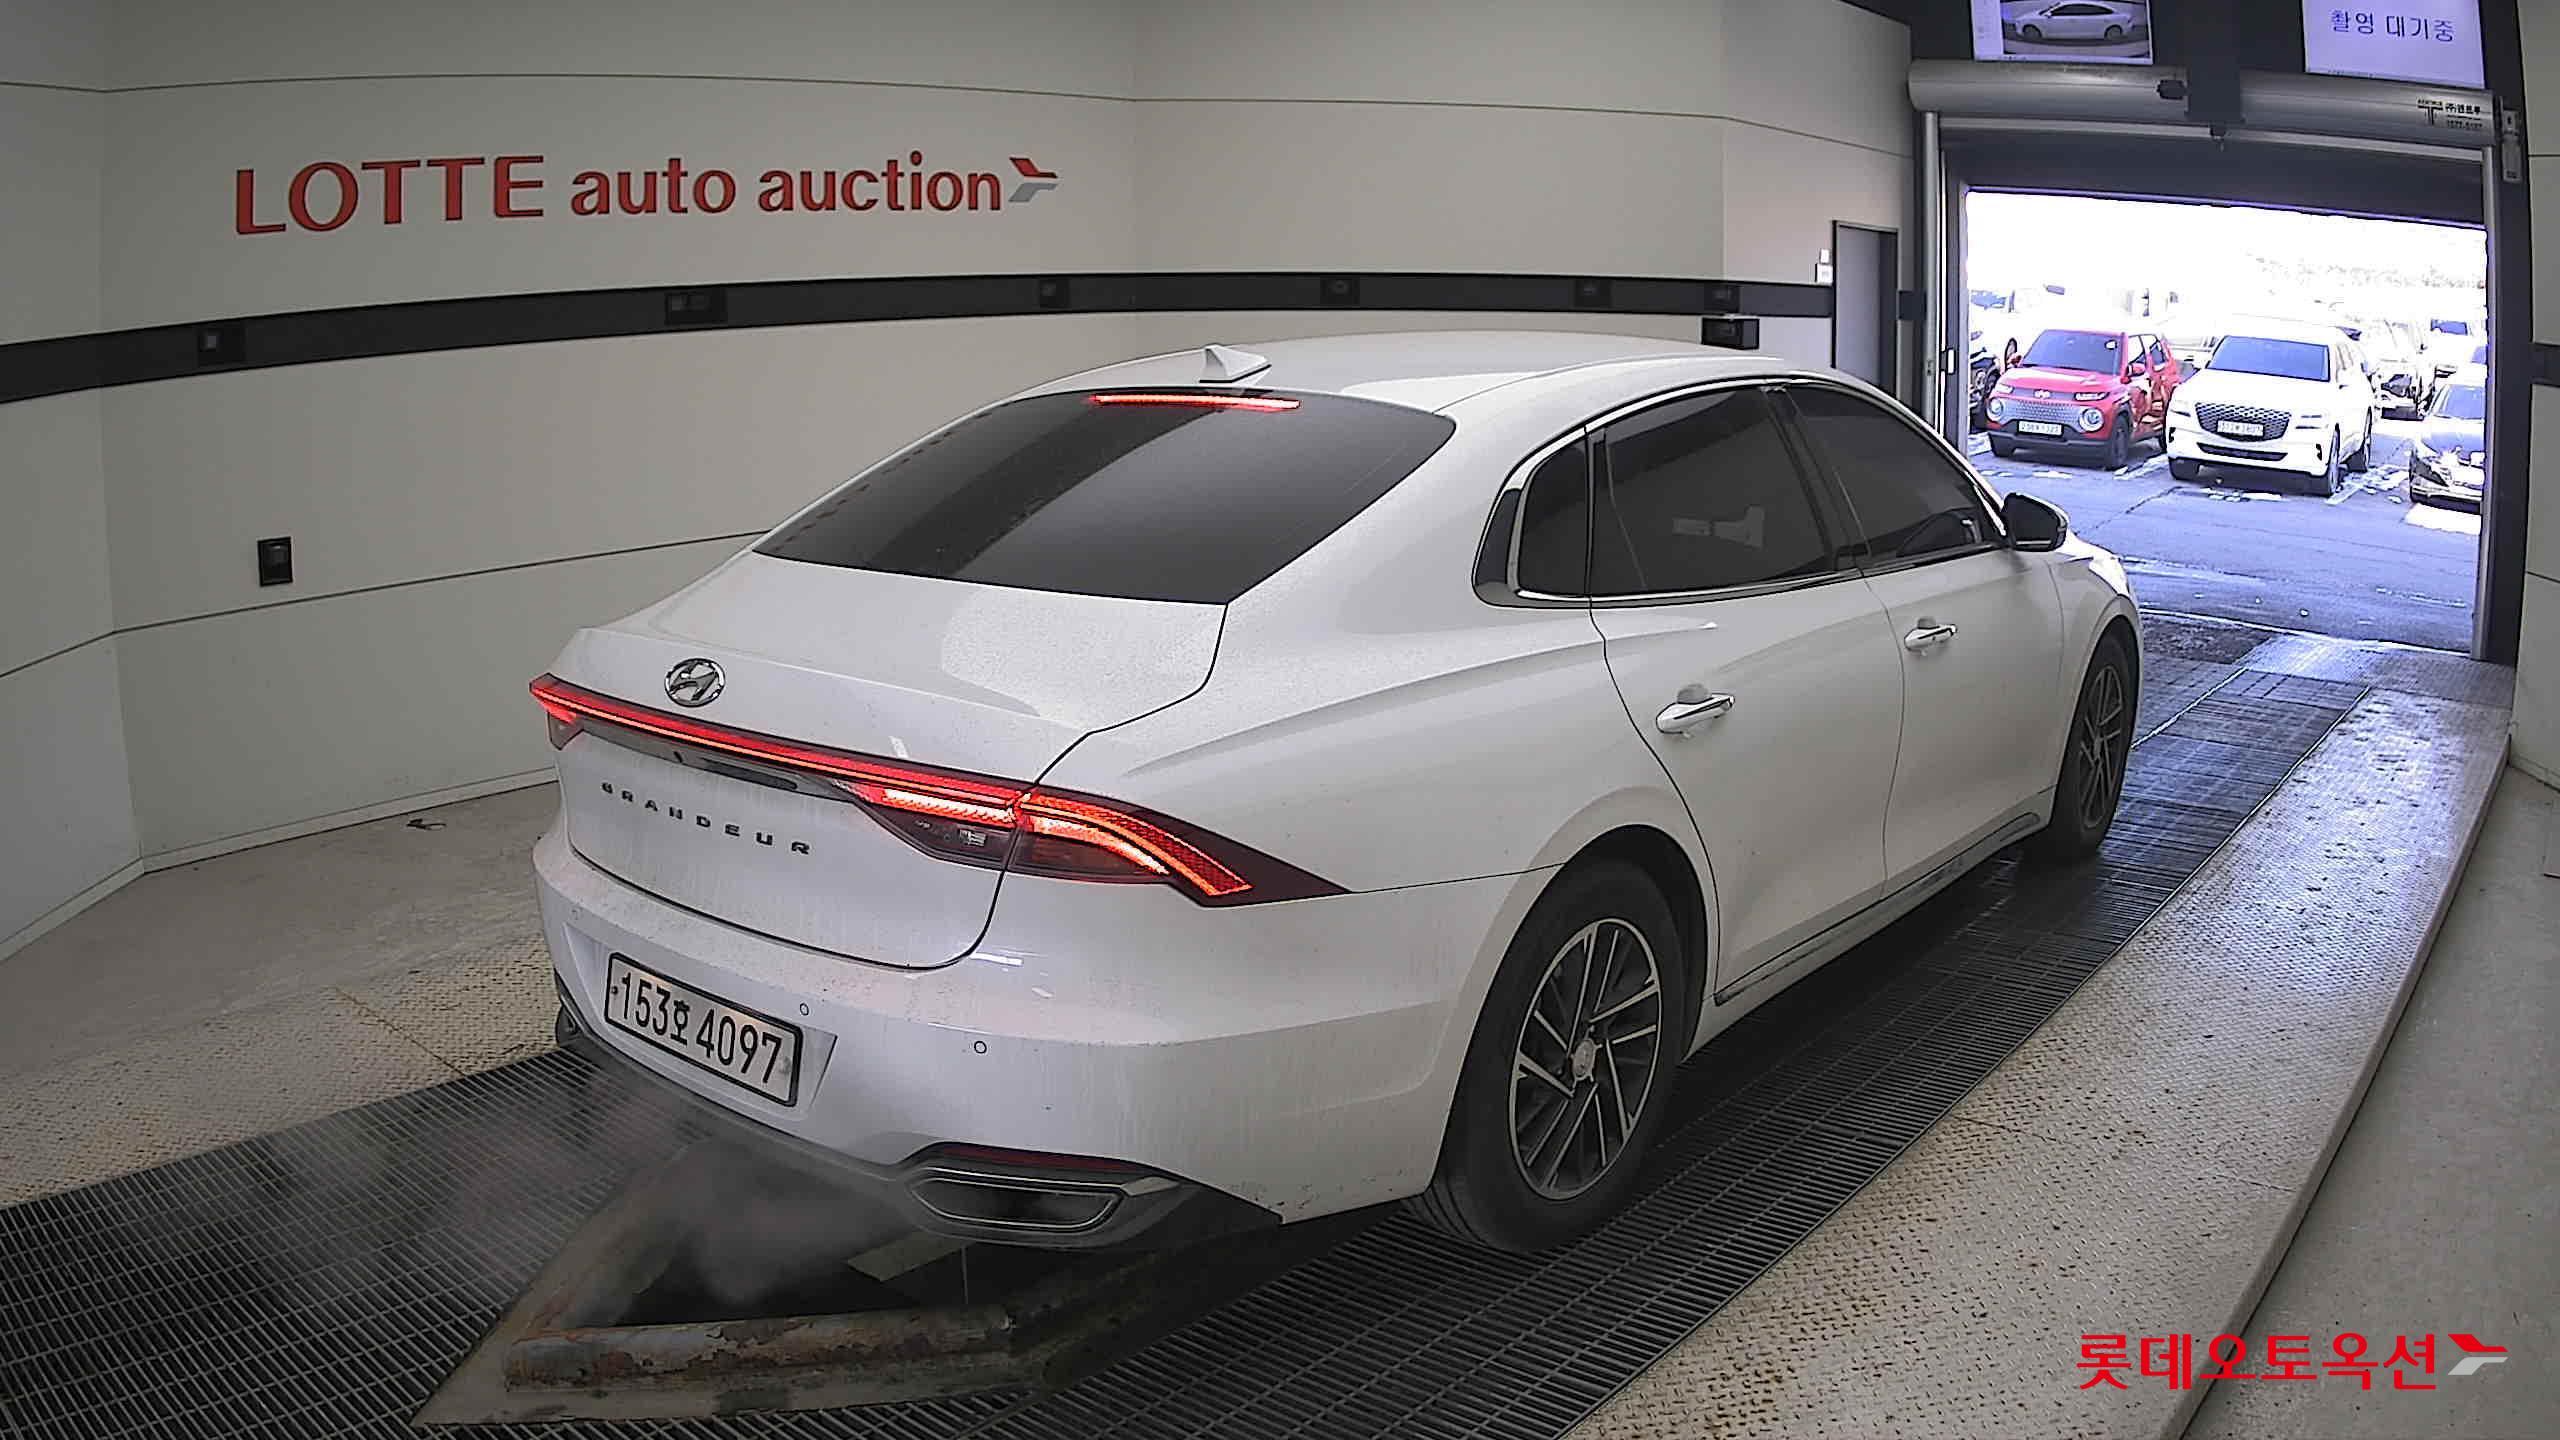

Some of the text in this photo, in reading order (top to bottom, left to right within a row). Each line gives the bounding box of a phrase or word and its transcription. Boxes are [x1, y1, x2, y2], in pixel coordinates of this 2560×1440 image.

[2331, 9, 2454, 42] 촬영 대기중
[236, 151, 1002, 234] LOTTE auto auction
[602, 782, 810, 855] GRANDEUR
[621, 972, 783, 1084] 153호 4097
